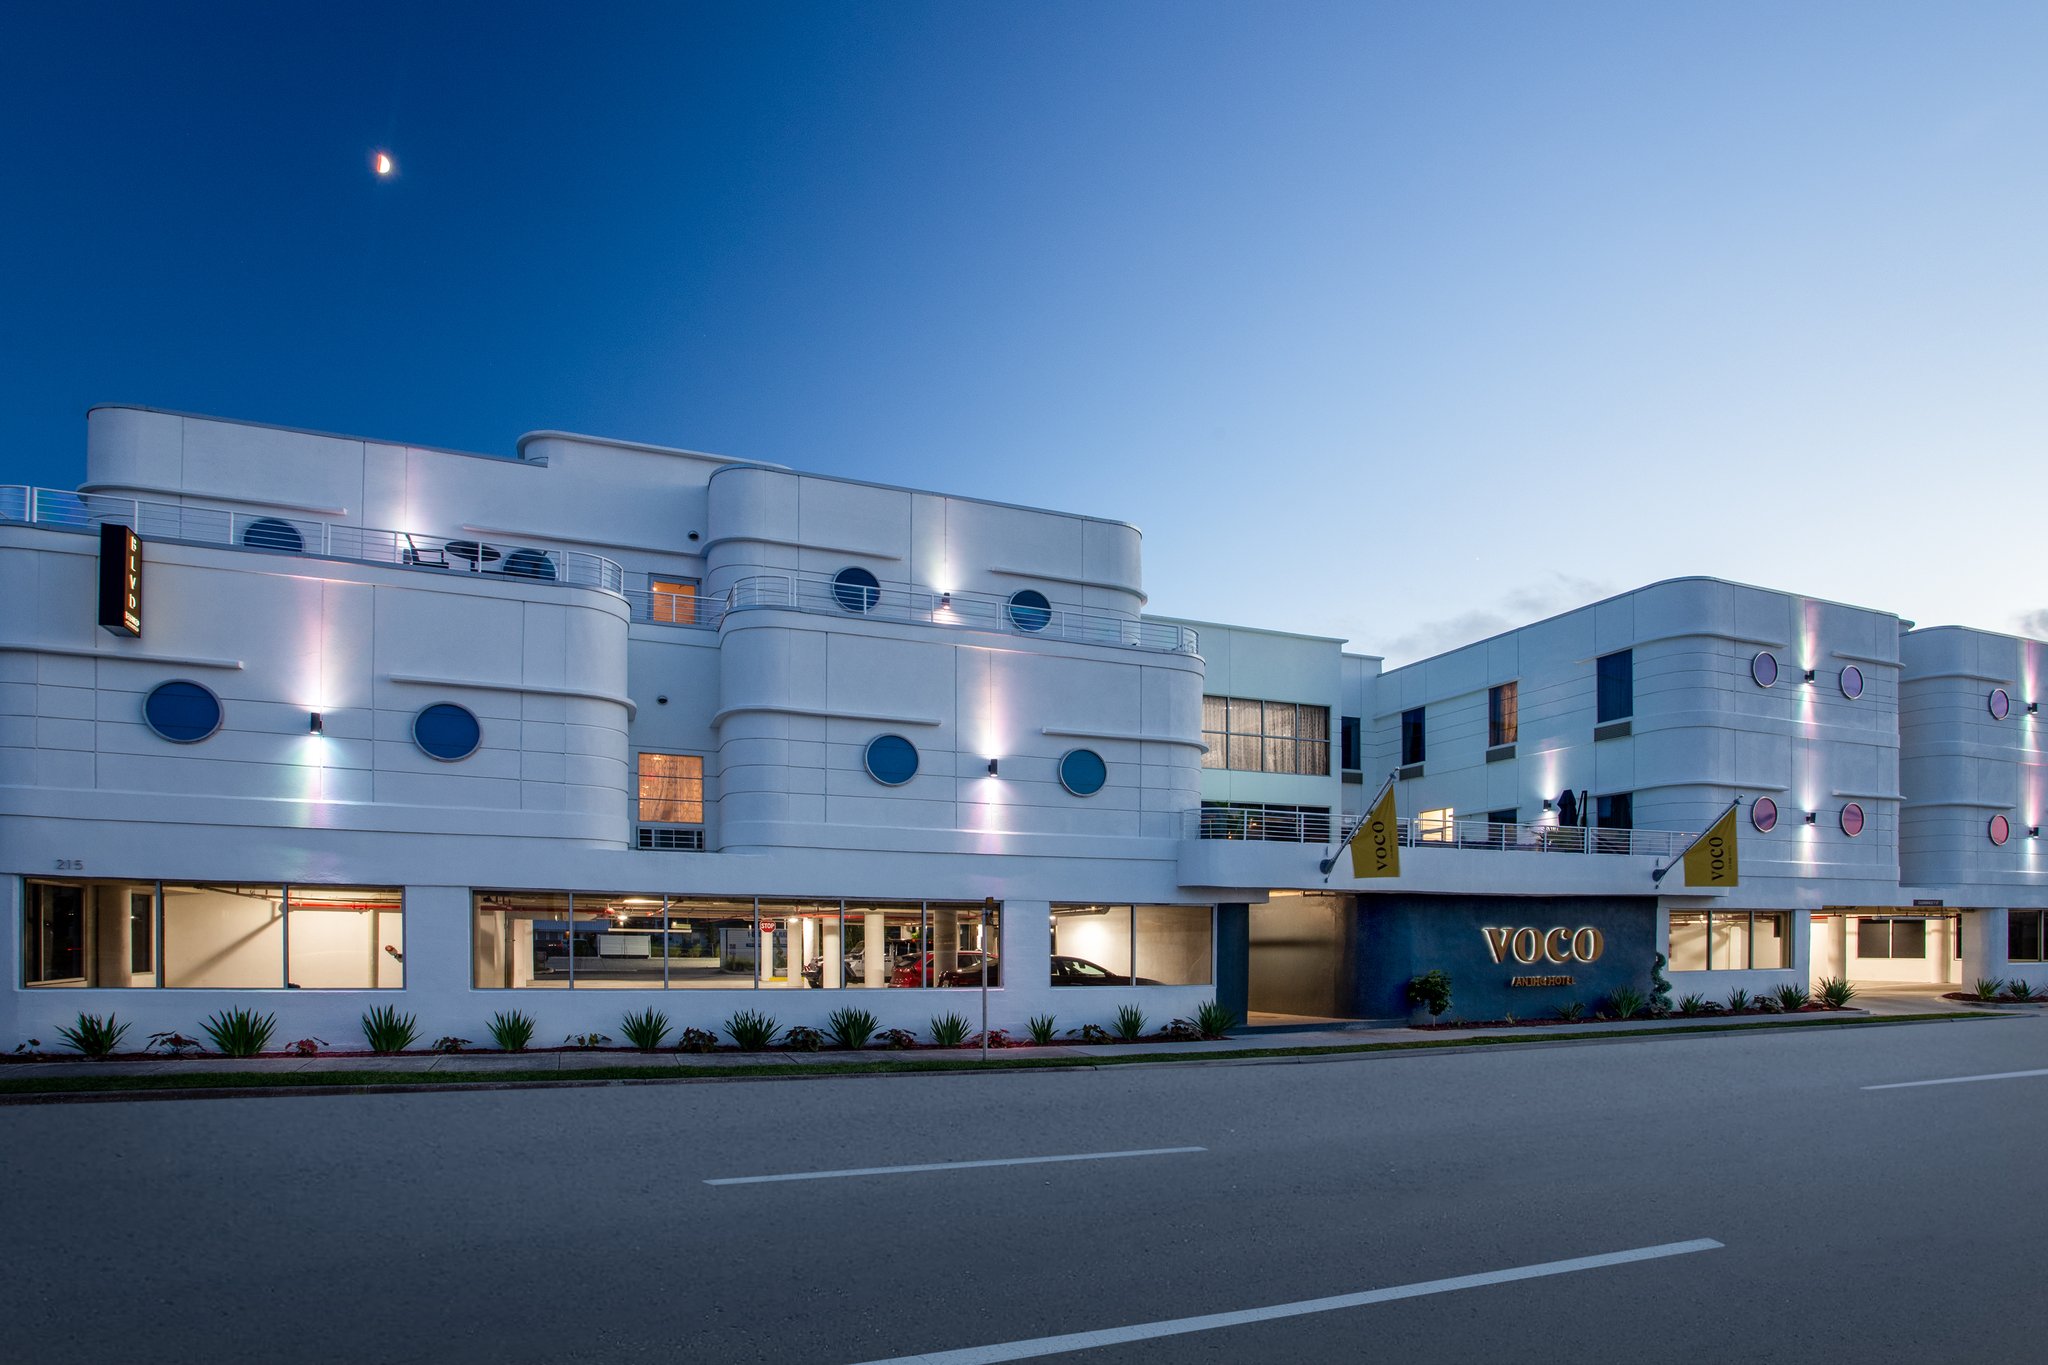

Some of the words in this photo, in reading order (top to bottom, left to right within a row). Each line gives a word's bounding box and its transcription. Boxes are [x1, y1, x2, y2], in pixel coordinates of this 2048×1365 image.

[56, 859, 83, 871] 215
[1372, 821, 1388, 871] VOCO
[1708, 837, 1725, 881] VOCO
[1481, 926, 1604, 964] VOCO
[1548, 976, 1577, 986] HOTEL
